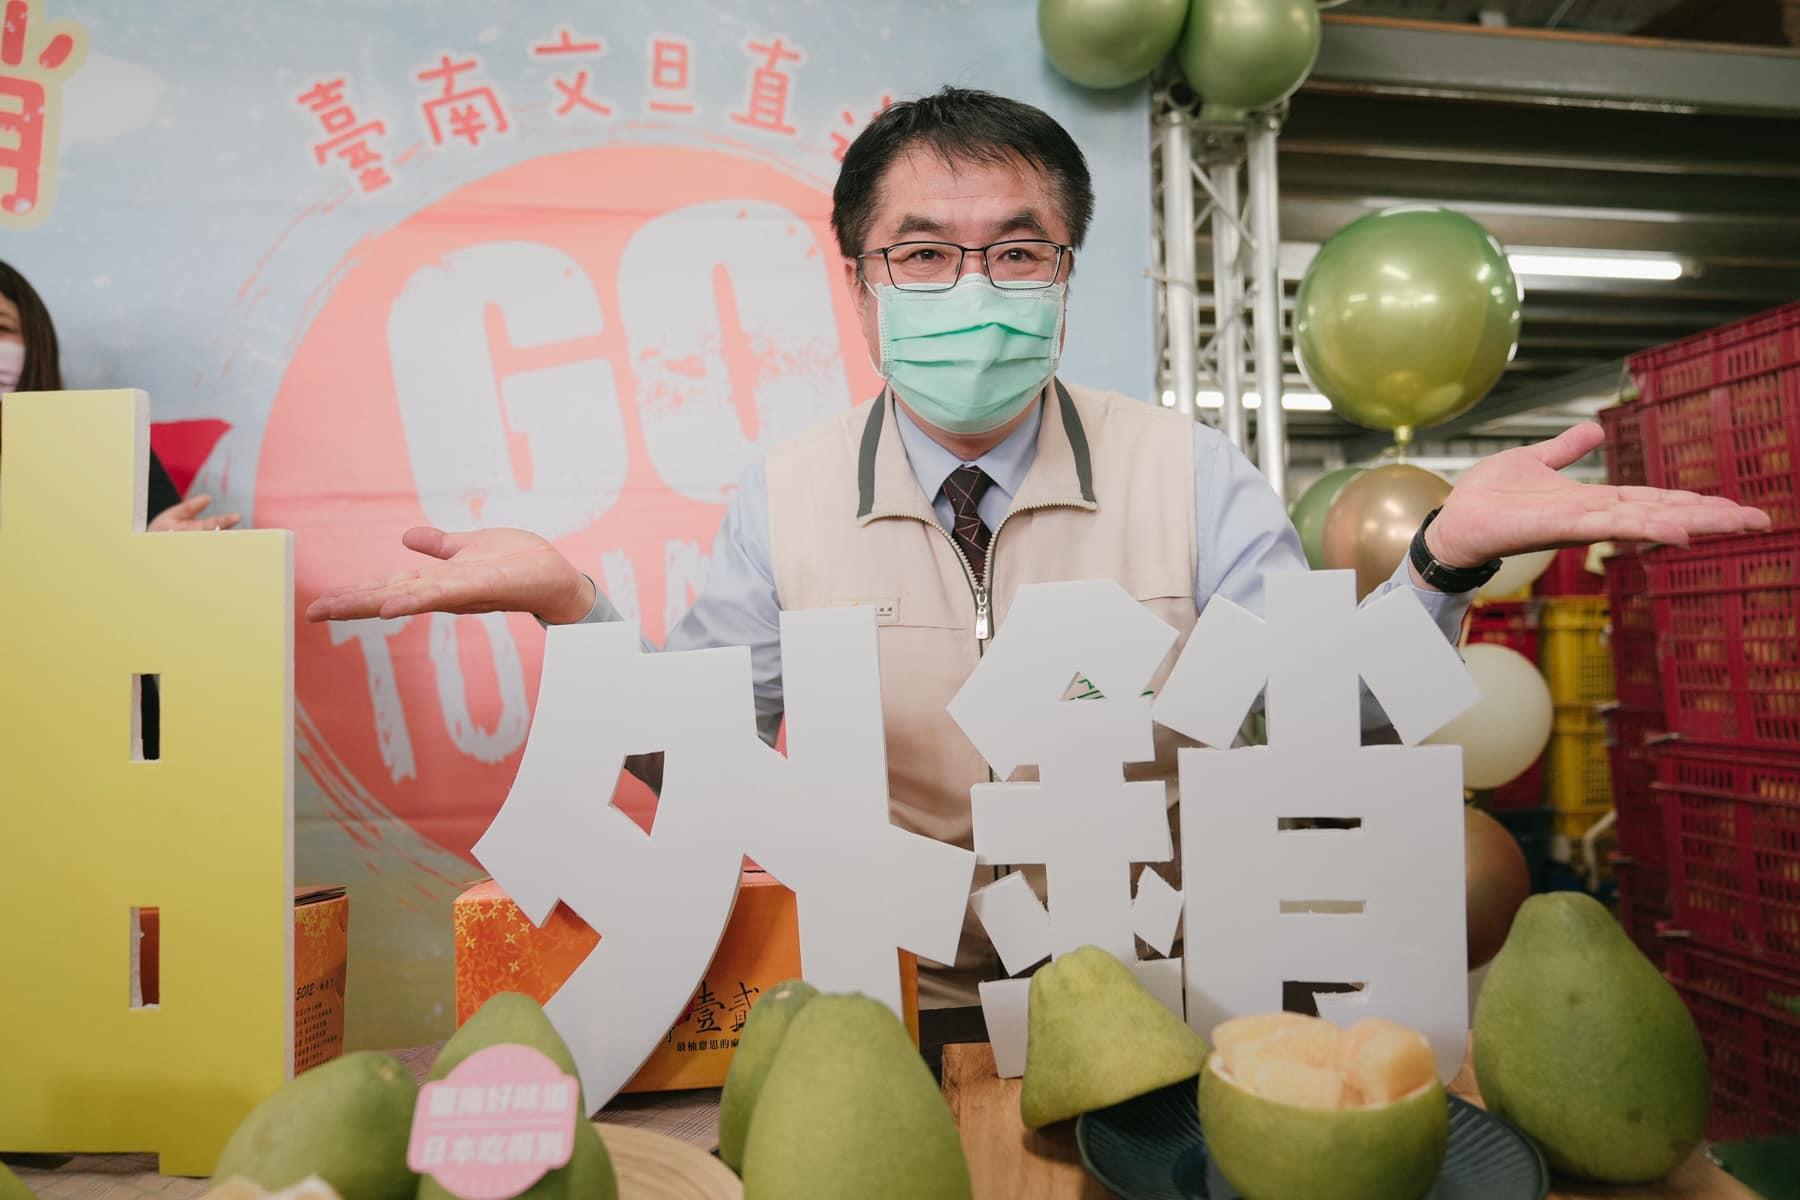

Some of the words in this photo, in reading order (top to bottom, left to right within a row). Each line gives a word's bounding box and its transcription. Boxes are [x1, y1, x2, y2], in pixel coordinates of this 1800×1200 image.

[297, 30, 890, 193] 臺南文旦直
[387, 199, 851, 541] GO
[667, 980, 760, 1043] 壹貳
